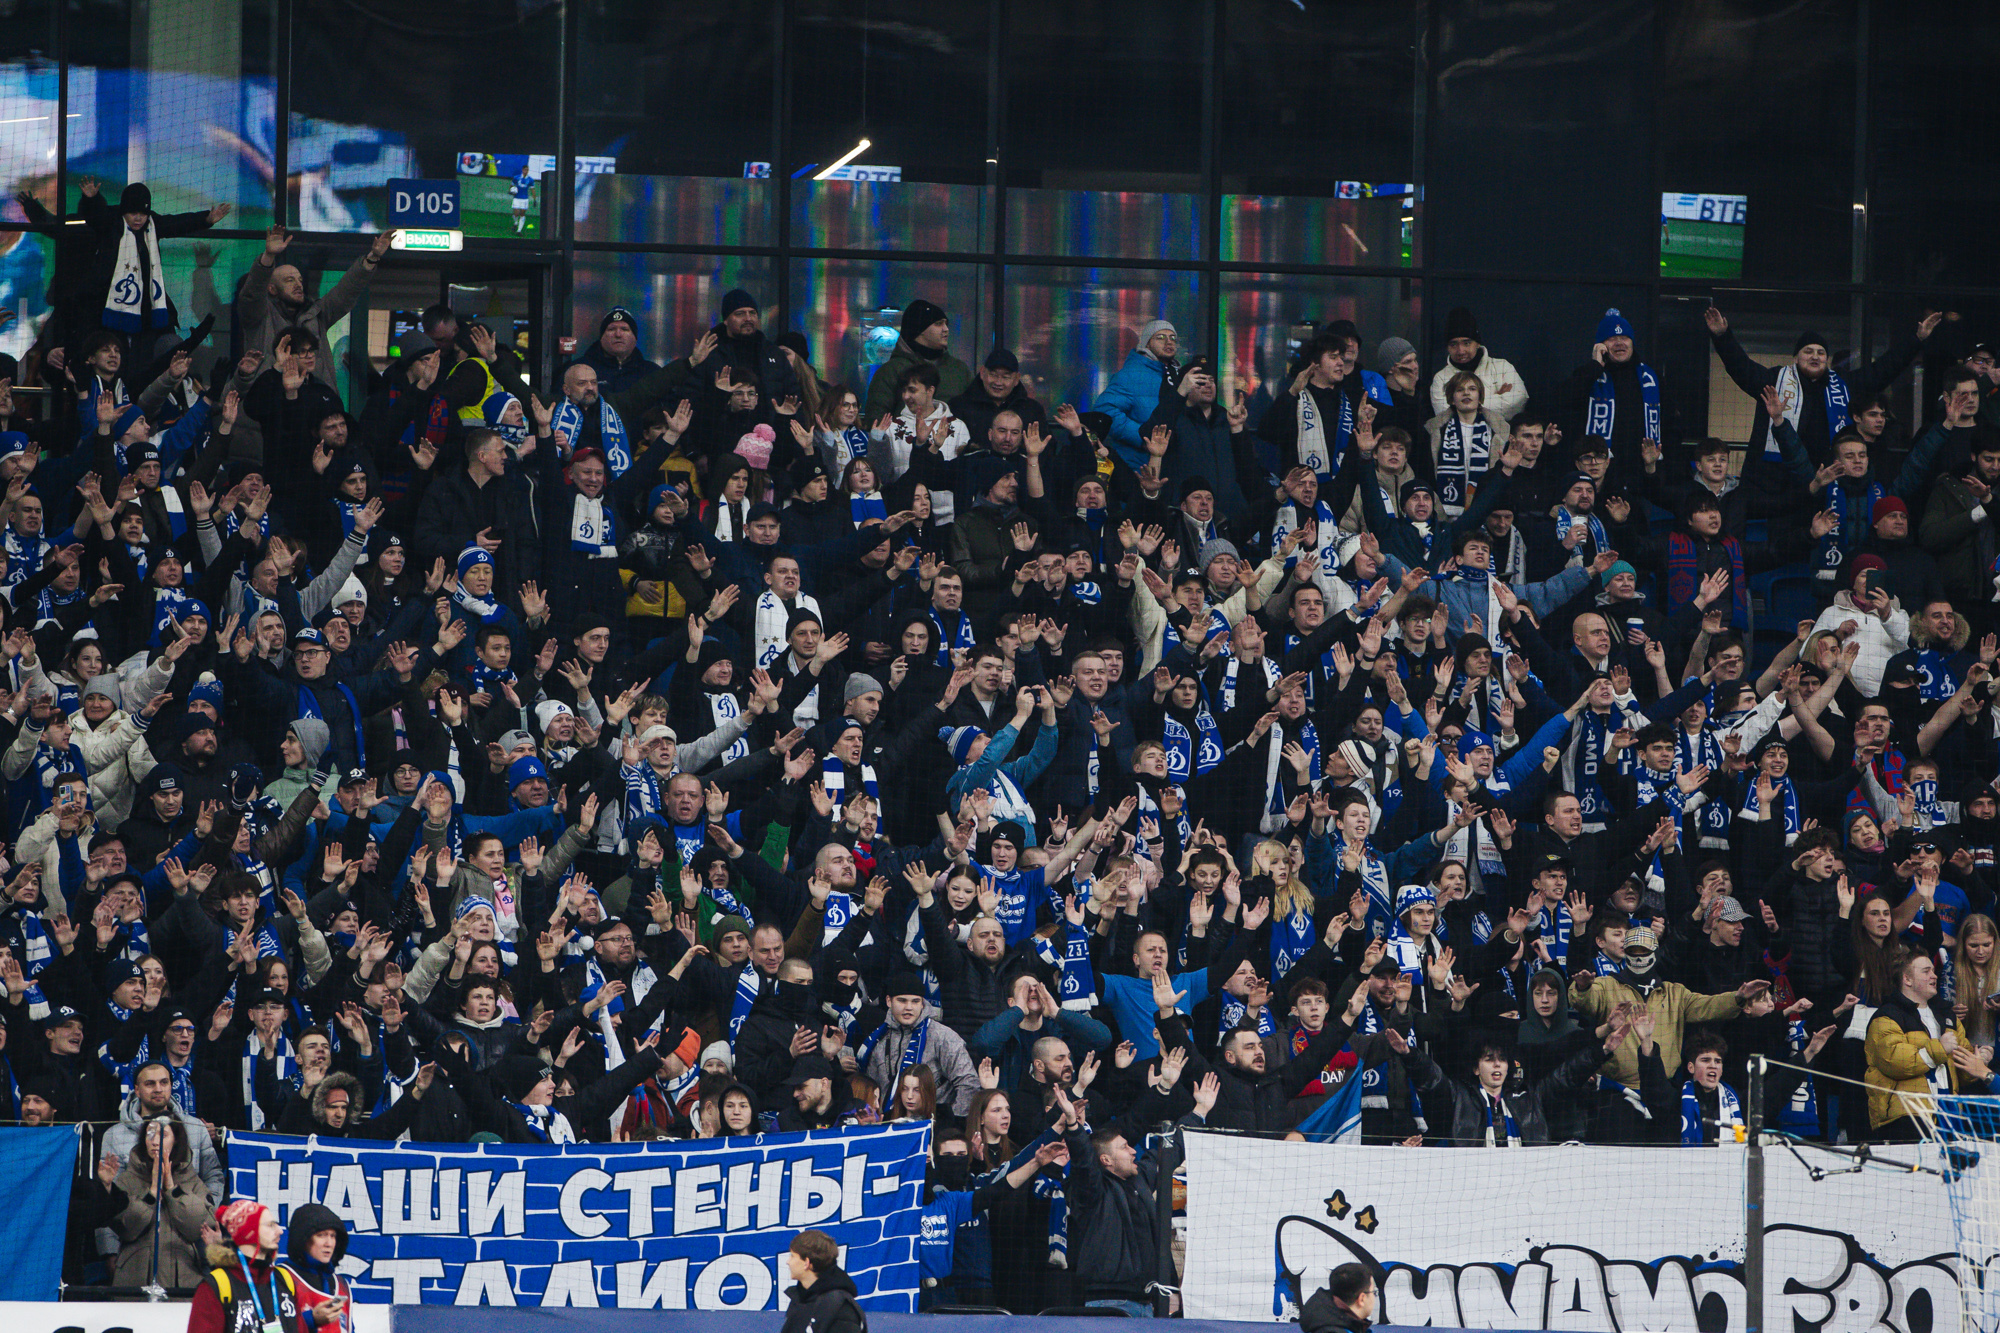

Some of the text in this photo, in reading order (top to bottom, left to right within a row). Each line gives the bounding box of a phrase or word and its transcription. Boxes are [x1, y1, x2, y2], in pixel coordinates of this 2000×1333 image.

[396, 192, 454, 214] D 105
[406, 233, 450, 247] ВЫХОД
[256, 1160, 527, 1237] НАШИ
